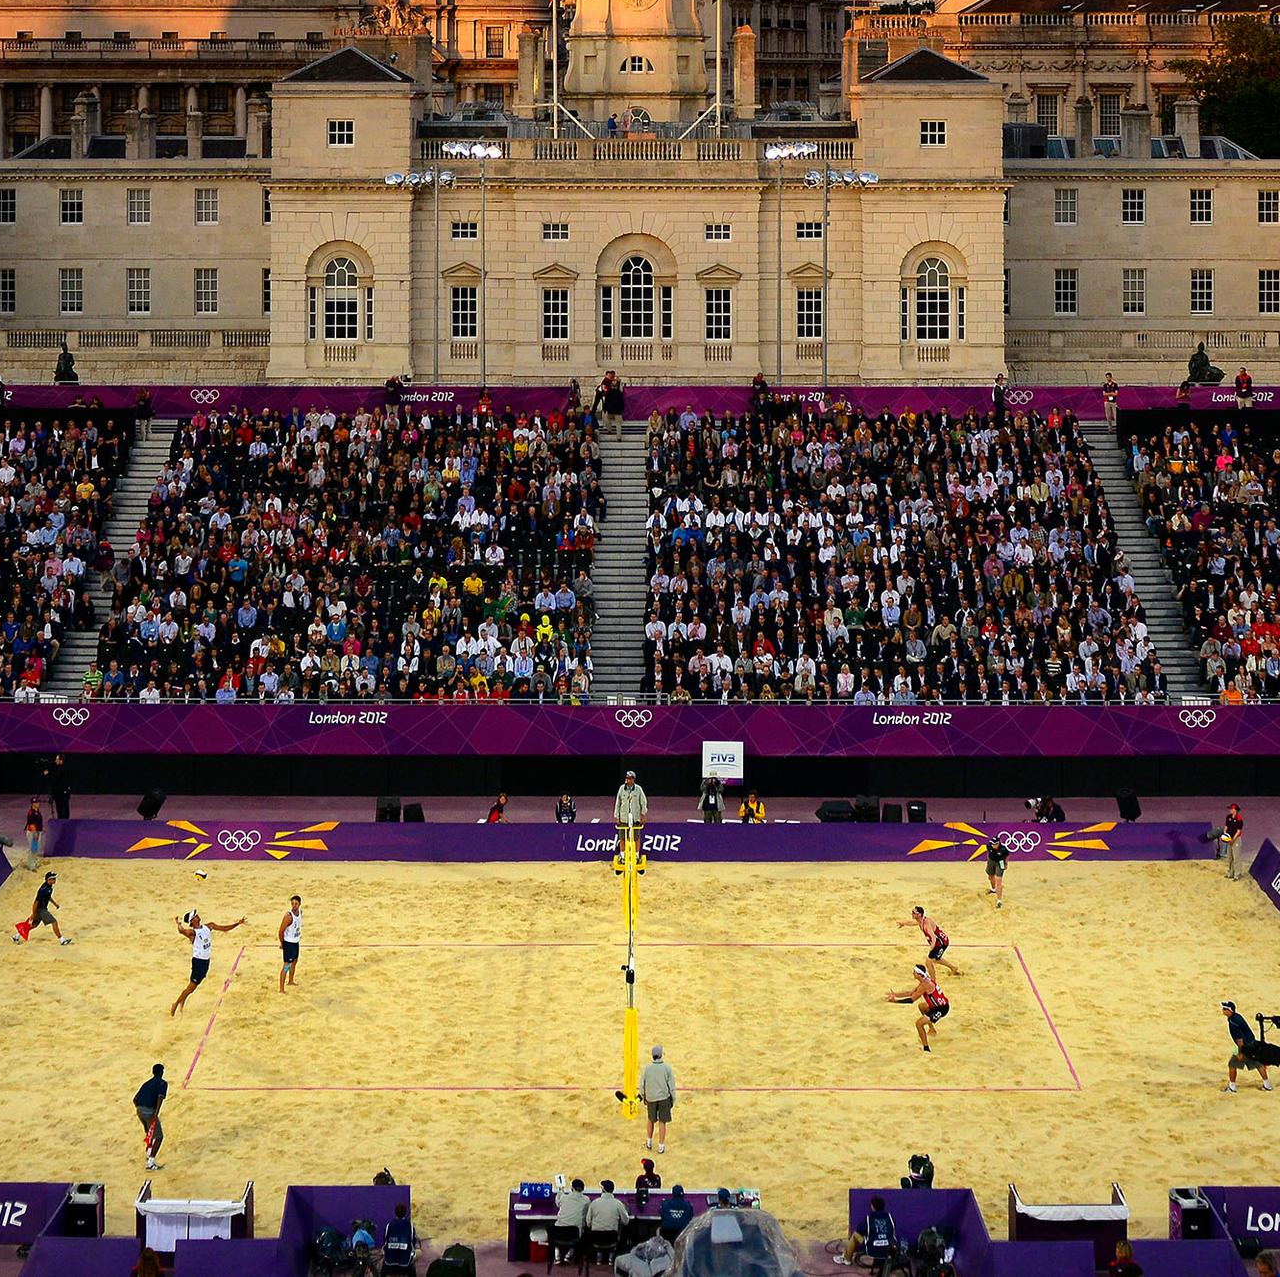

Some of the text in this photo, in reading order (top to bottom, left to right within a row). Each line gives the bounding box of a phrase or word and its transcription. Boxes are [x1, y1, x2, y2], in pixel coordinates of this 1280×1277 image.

[431, 391, 455, 402] 2012
[807, 391, 825, 403] 201
[1251, 391, 1275, 403] 2012
[309, 710, 388, 724] London 2012
[872, 711, 952, 725] London 2012
[710, 753, 736, 763] FIVB
[576, 833, 682, 852] Lond 2012
[522, 1187, 529, 1198] 4
[543, 1188, 551, 1198] 3
